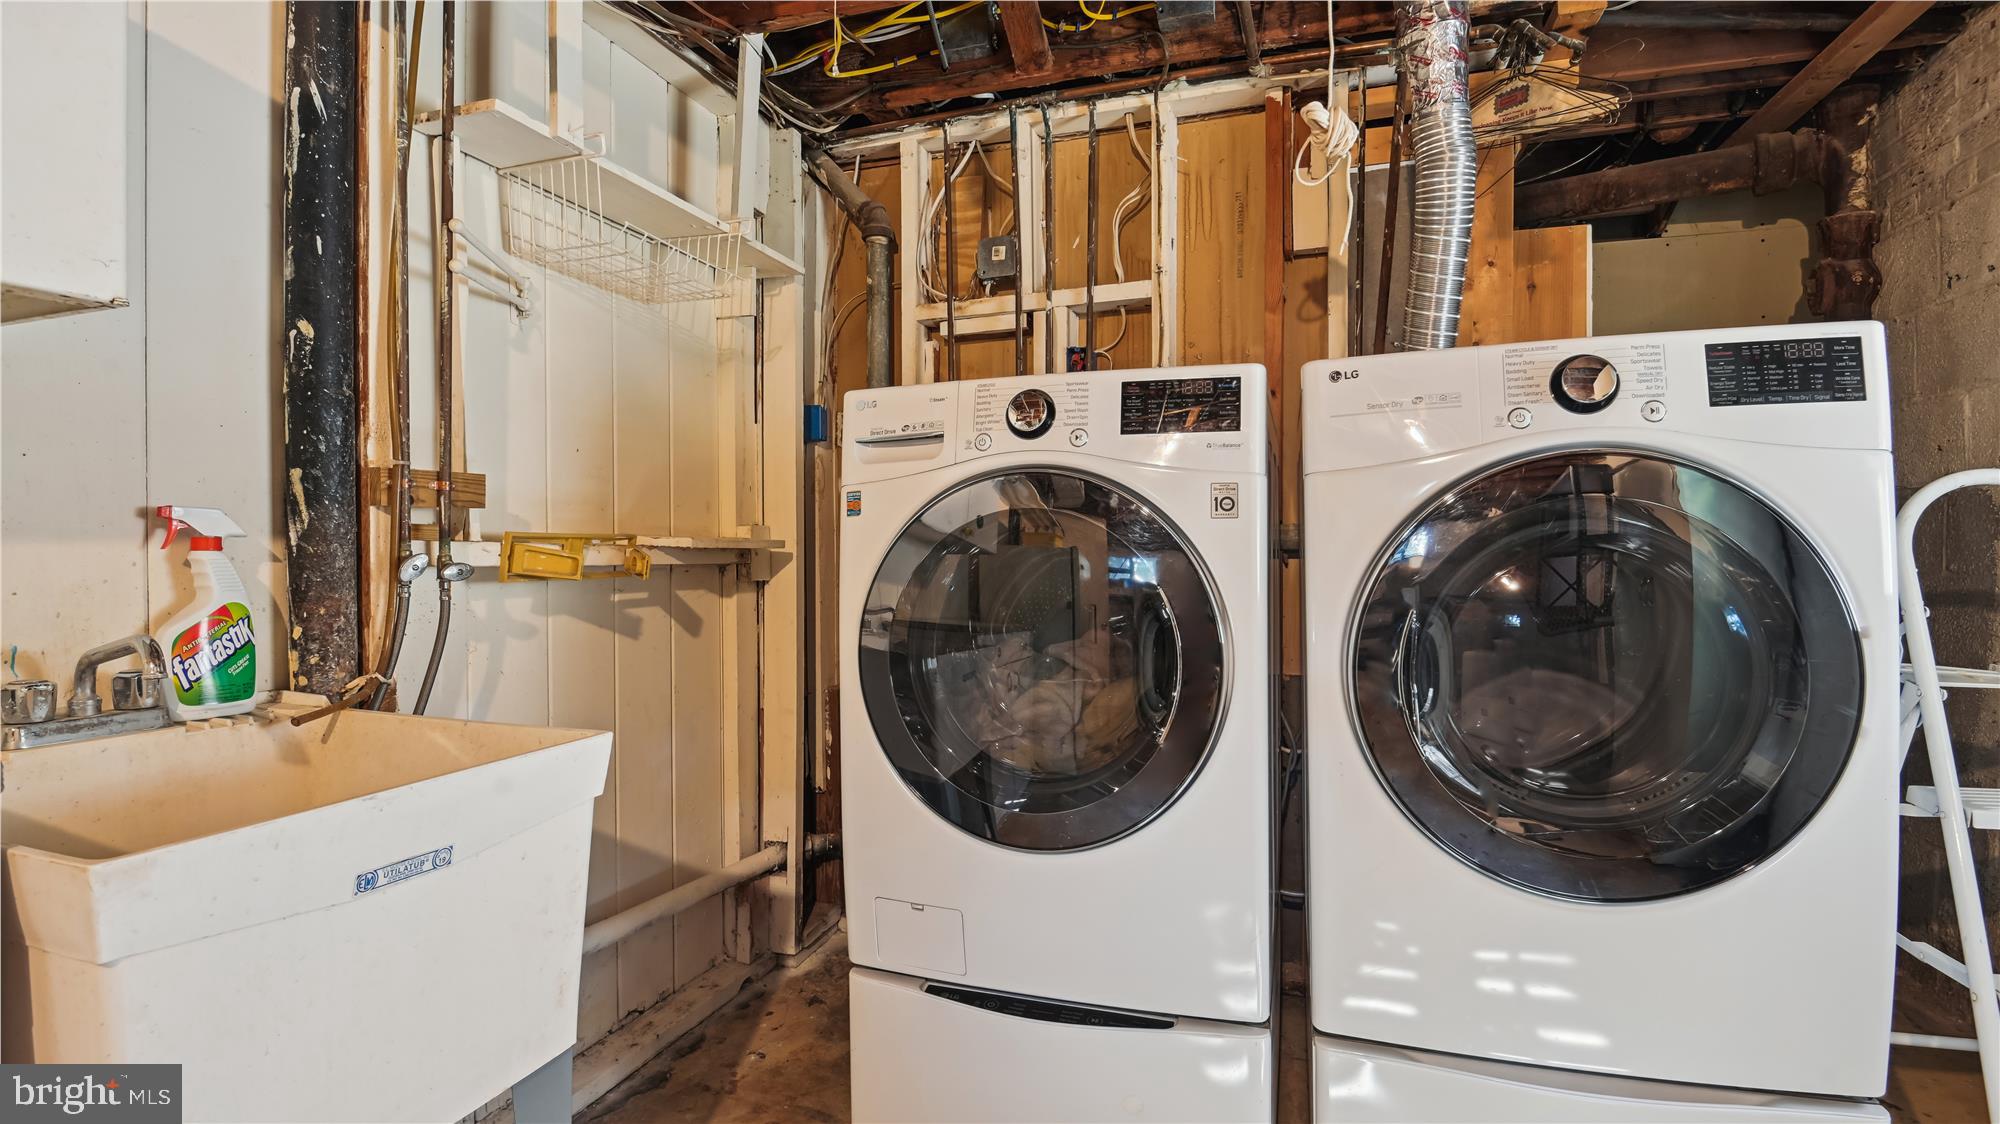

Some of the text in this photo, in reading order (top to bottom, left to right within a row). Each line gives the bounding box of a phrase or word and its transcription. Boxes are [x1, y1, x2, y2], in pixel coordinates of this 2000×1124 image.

[1344, 370, 1359, 380] LG
[867, 400, 878, 409] LG
[1367, 400, 1403, 410] Sensor Dry
[869, 429, 884, 437] Direct
[1213, 496, 1236, 512] 10
[172, 617, 256, 691] fantastik
